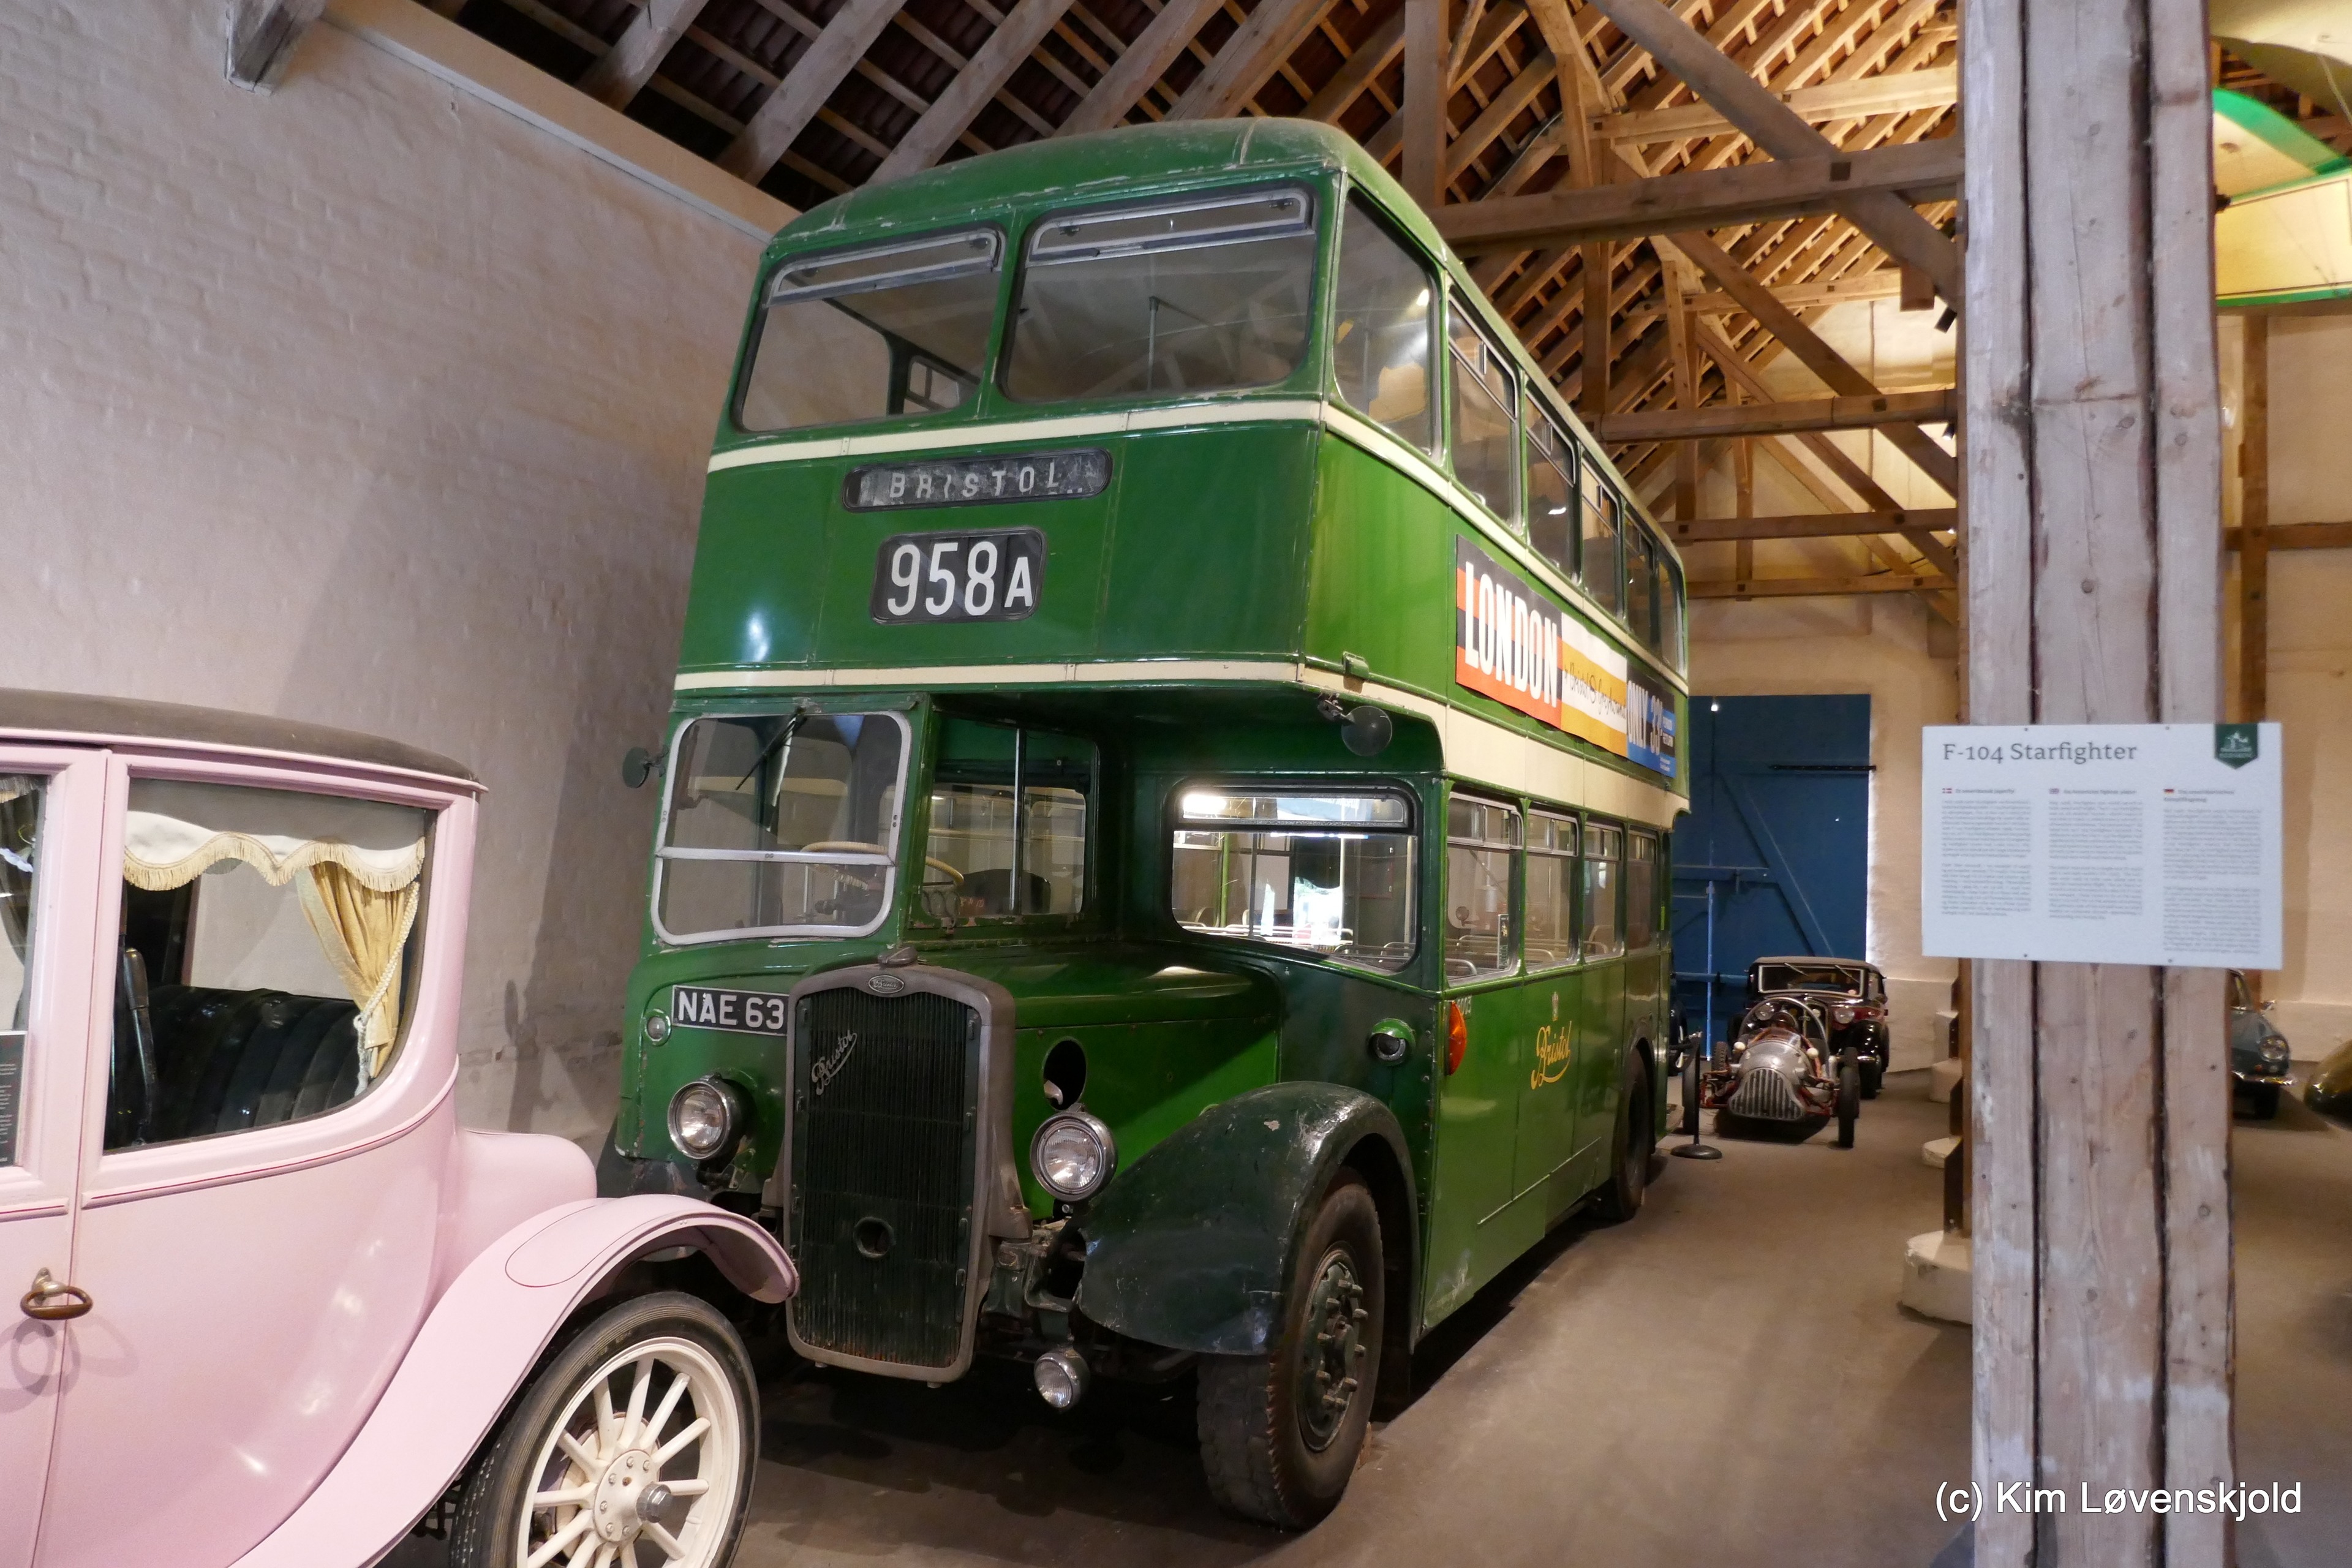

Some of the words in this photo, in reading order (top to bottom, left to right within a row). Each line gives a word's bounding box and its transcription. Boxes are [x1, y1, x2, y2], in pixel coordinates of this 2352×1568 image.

[889, 462, 1059, 499] BRISTOL
[888, 541, 1033, 616] 958A
[1464, 560, 1558, 708] LONDON
[1627, 679, 1649, 750] ONLY
[1943, 743, 2003, 764] F-104
[2010, 741, 2137, 765] Starfighter
[678, 990, 738, 1026] NAE
[745, 997, 785, 1030] 63
[811, 1029, 858, 1095] Bristol
[1531, 1020, 1573, 1090] Bristol
